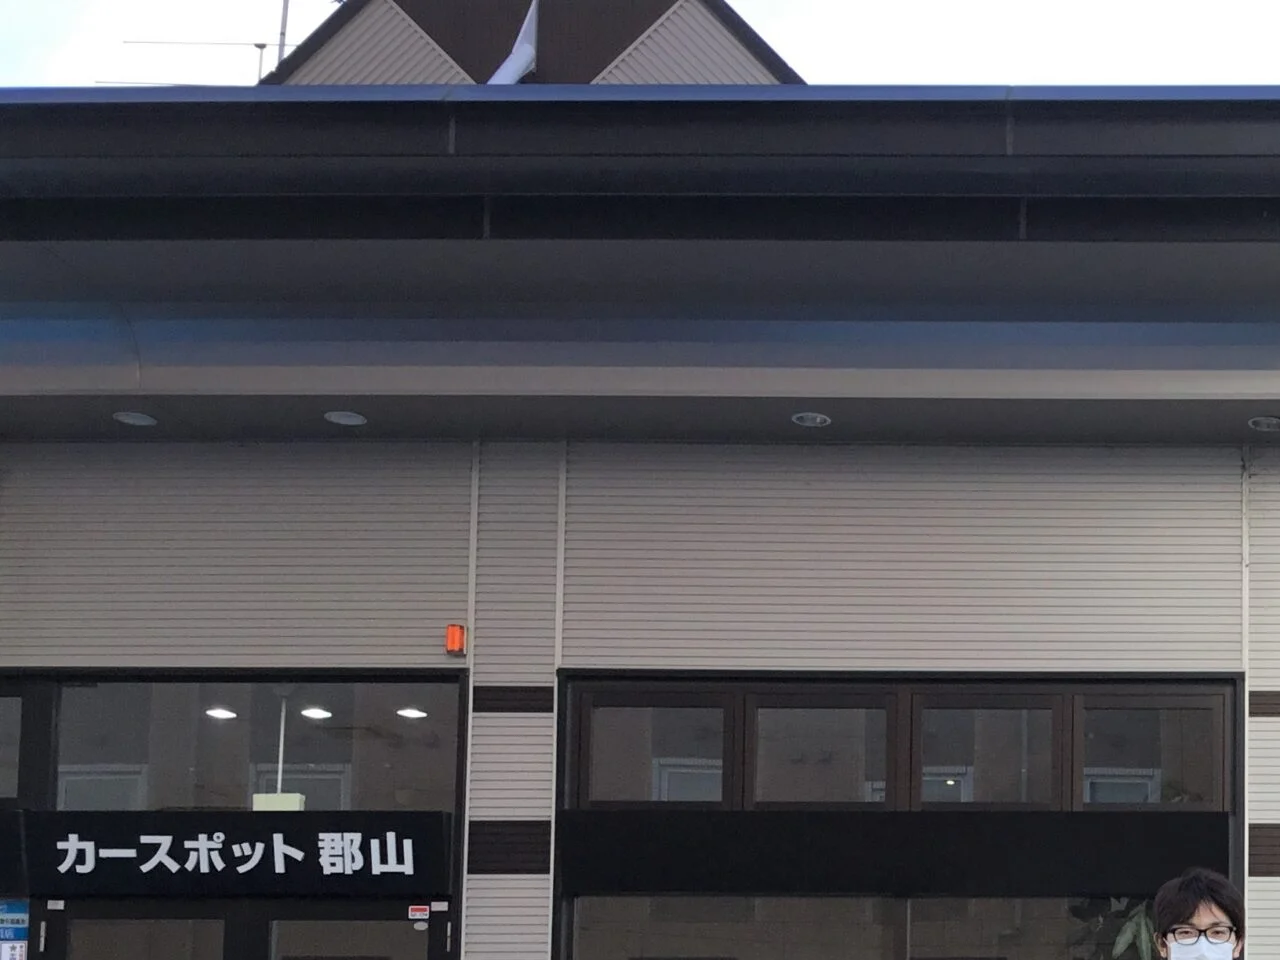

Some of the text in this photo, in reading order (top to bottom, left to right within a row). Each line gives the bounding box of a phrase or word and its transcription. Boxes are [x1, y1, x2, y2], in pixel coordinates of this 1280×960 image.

[56, 831, 414, 875] カースポット 郡山
